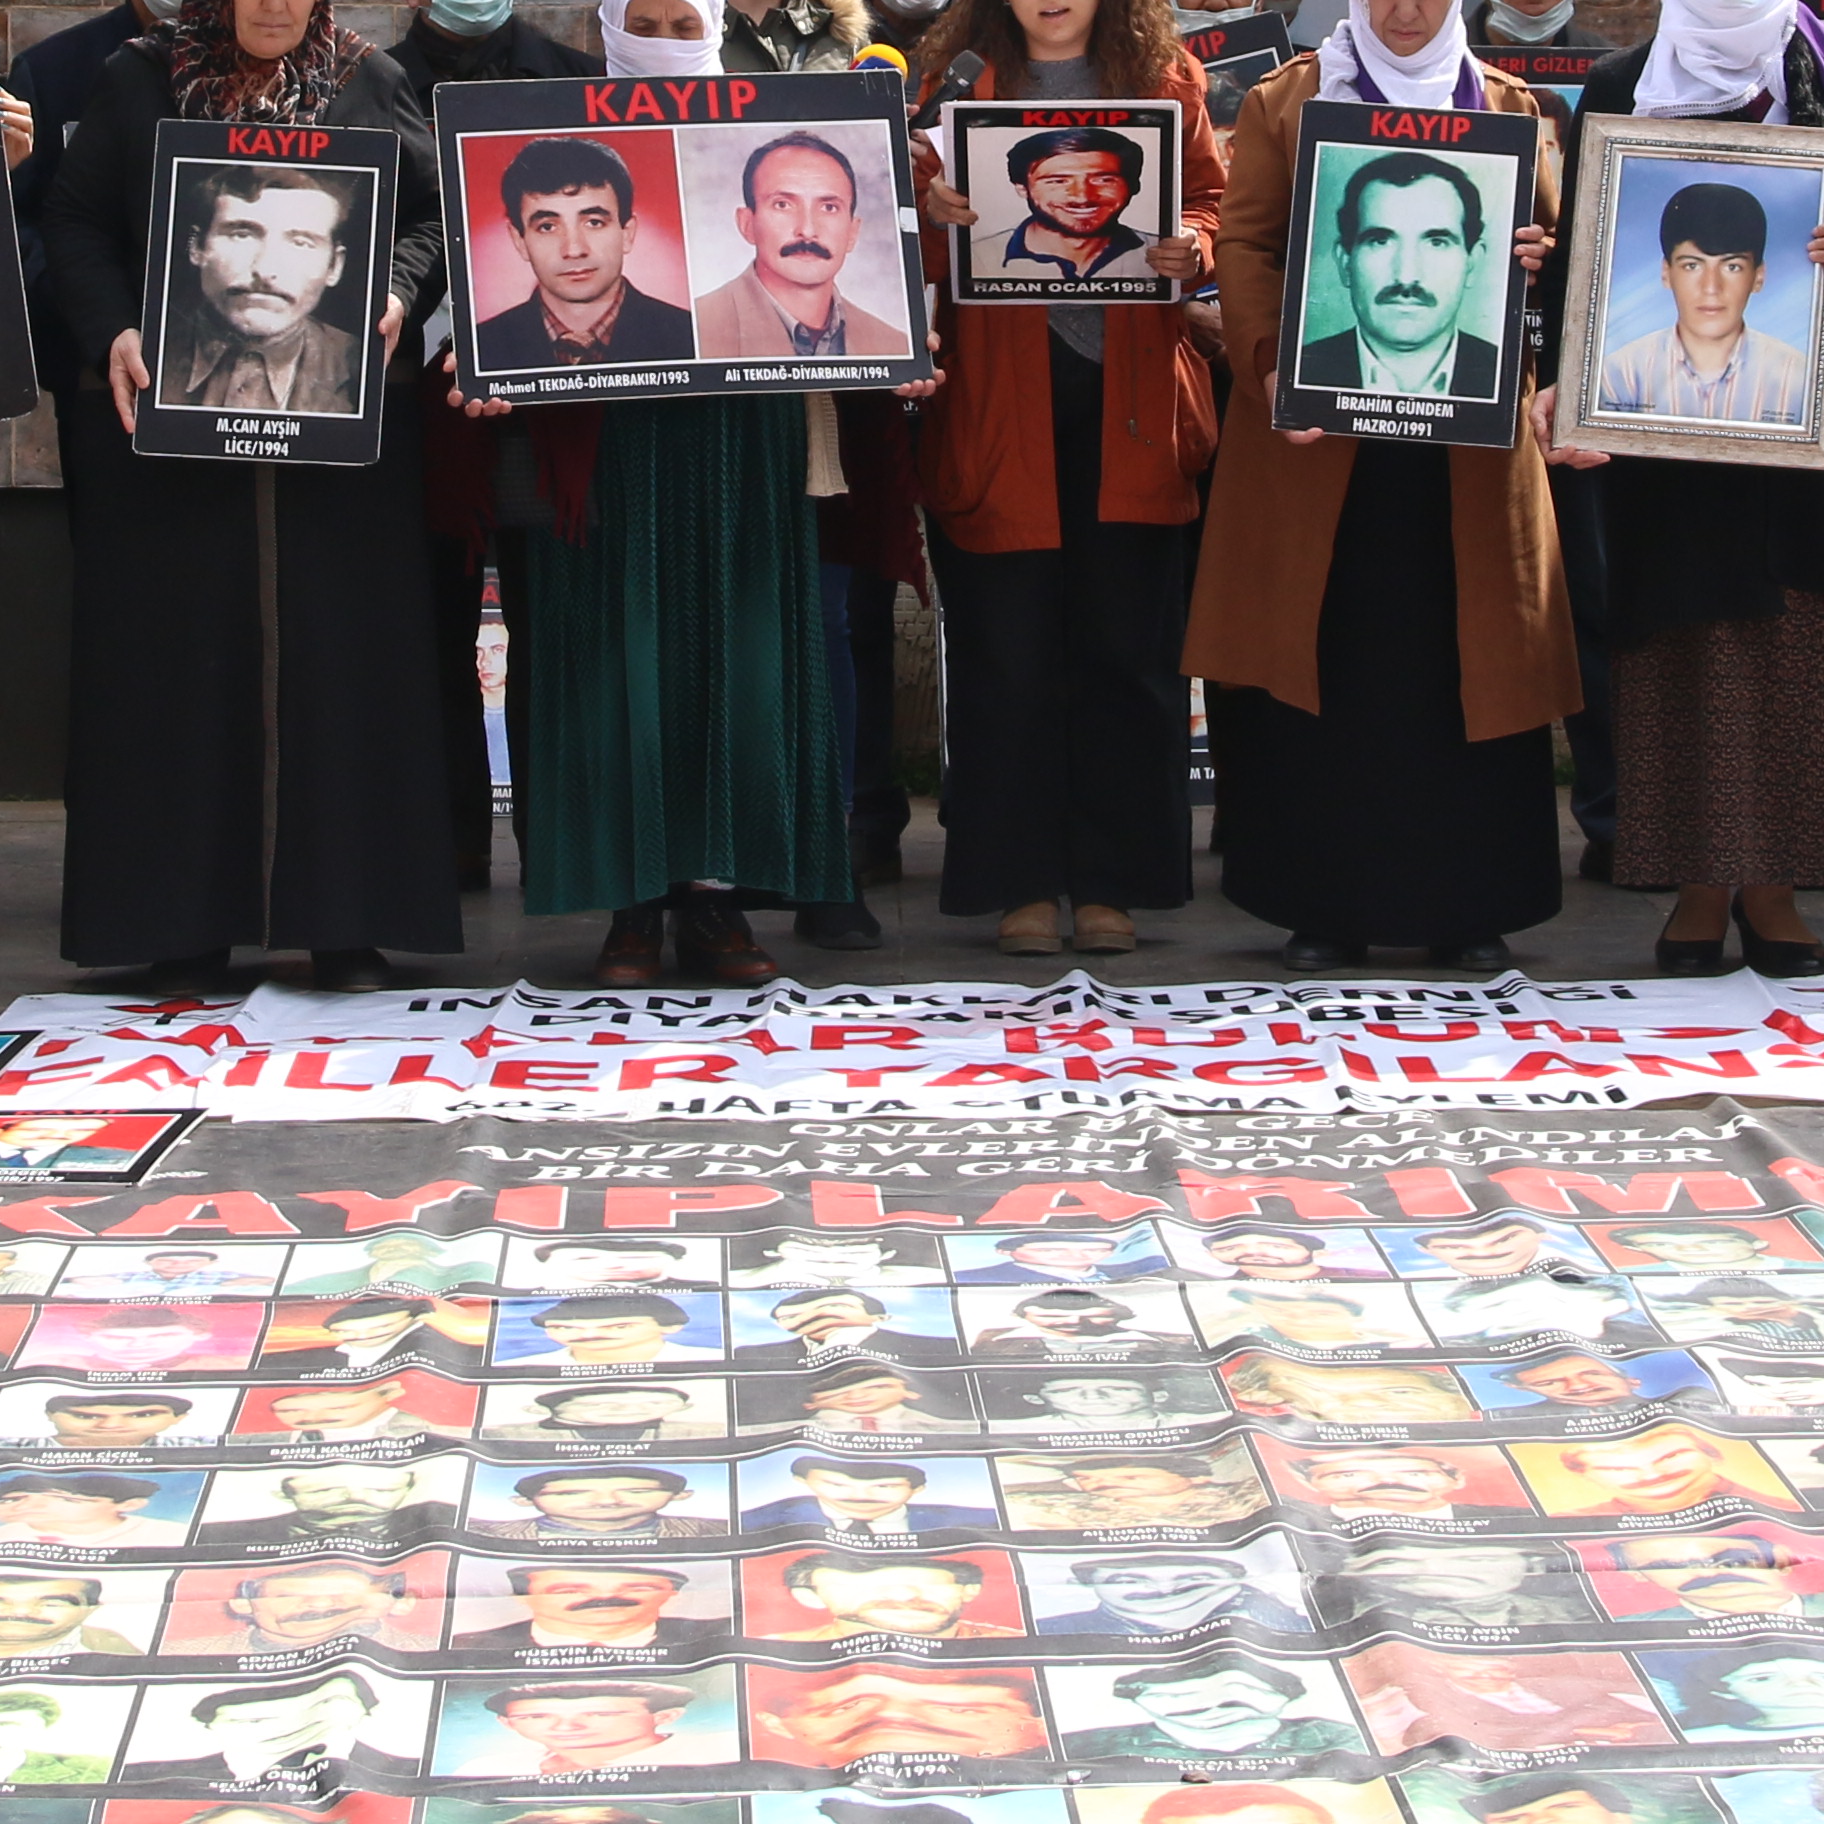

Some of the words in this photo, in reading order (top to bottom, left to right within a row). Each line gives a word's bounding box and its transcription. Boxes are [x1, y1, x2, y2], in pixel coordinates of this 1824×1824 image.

[583, 80, 758, 124] KAYIP
[1021, 110, 1130, 127] KAYIP
[1361, 110, 1463, 143] KAYIP
[227, 126, 331, 160] KAYIP
[973, 282, 1043, 293] HASAN
[1047, 281, 1157, 293] OCAK-1995
[488, 380, 536, 396] Mehmet
[537, 370, 690, 393] TEKDAĞ-DİYARBAKIR/1993
[724, 367, 741, 383] Ali
[742, 365, 890, 383] TEKDAĞ-DİYARBAKIR/1994
[1335, 392, 1393, 414] İBRAHİM
[1394, 396, 1454, 418] GÜNDEM
[215, 417, 260, 435] M.CAN
[261, 416, 301, 440] AYŞİN
[1351, 416, 1433, 437] HAZRO/1991
[224, 436, 289, 457] LİCE/1994
[657, 1095, 918, 1116] HAFTA
[789, 1119, 1057, 1138] ONLAR
[1236, 1109, 1438, 1131] GECE
[455, 1139, 792, 1163] ANSIZIN
[529, 1161, 673, 1181] BİR
[695, 1159, 934, 1180] DAHA
[955, 1149, 1150, 1175] GERİ
